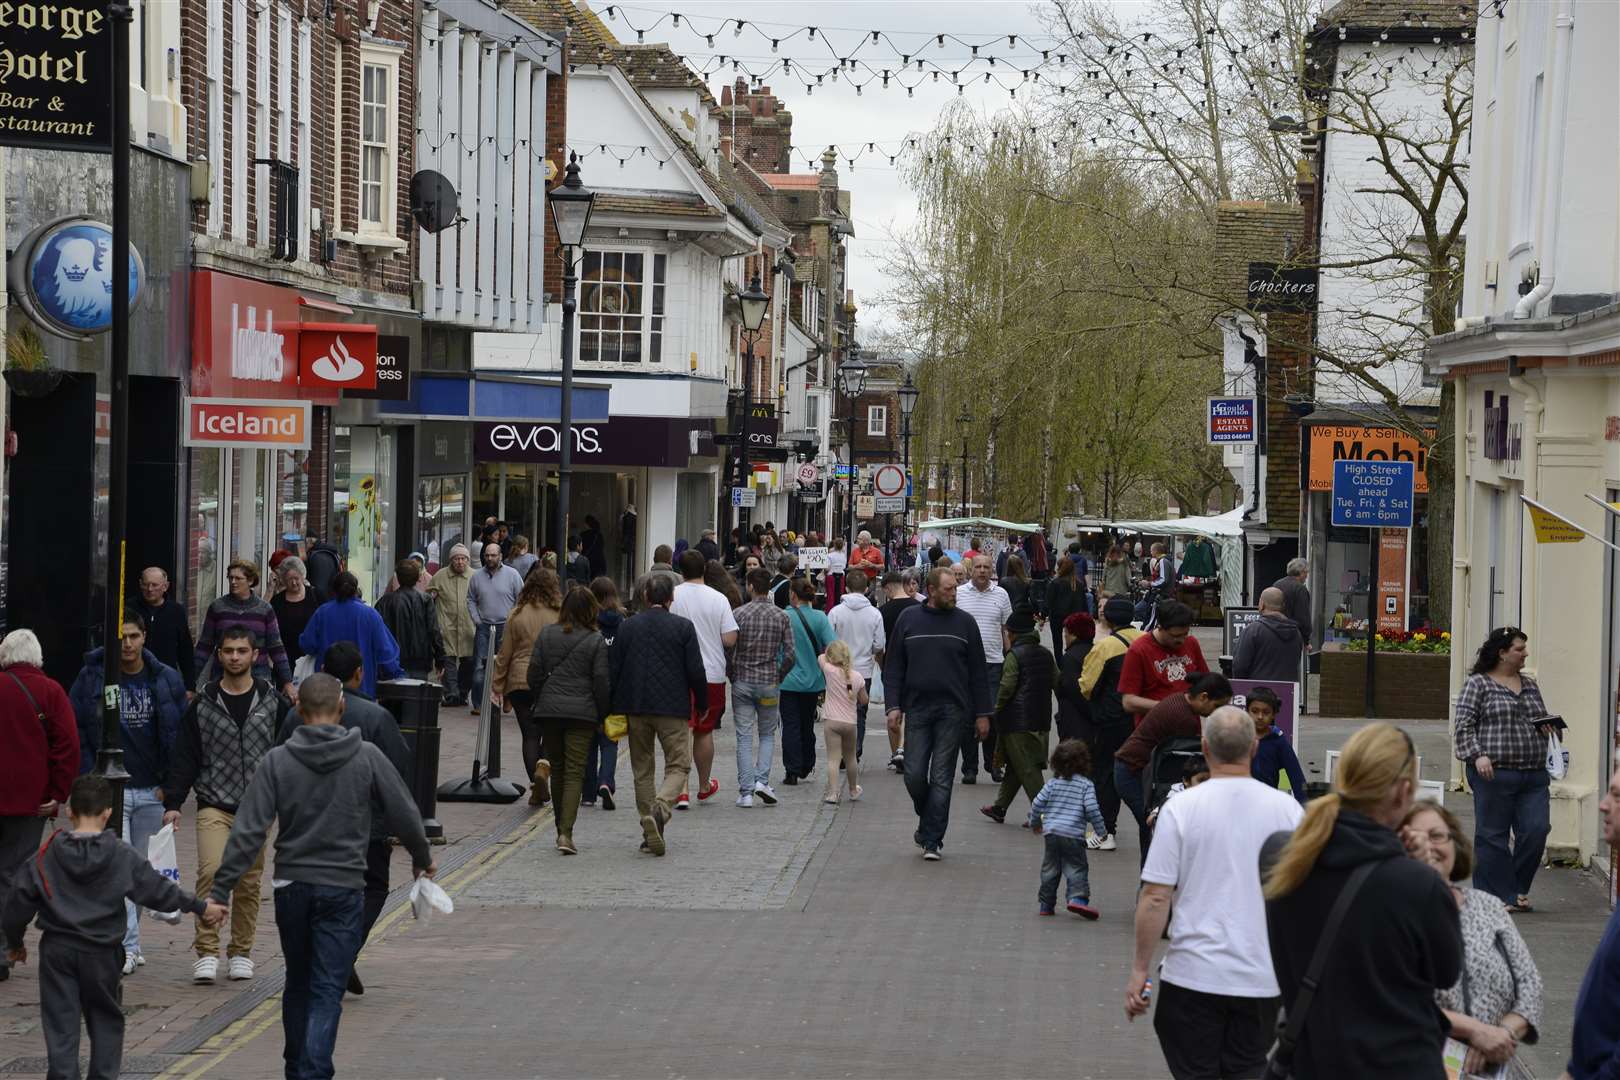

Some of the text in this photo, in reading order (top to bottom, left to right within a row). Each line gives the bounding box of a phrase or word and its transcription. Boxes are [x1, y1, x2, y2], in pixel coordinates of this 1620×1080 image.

[0, 1, 104, 40] eorge
[0, 92, 65, 111] Bar &
[1249, 280, 1316, 295] Chockers
[1212, 406, 1249, 416] Harrison
[1216, 402, 1245, 412] Gould
[199, 410, 296, 437] Iceland
[489, 424, 602, 453] evans.
[1312, 427, 1332, 438] We
[1336, 428, 1359, 440] Buy
[1362, 428, 1372, 438] &
[1375, 428, 1398, 439] Sell
[801, 467, 814, 478] £9
[1345, 464, 1402, 475] High Street
[1352, 476, 1394, 486] CLOSED
[1358, 487, 1388, 496] ahead
[1337, 497, 1409, 509] Tue. Fri. & Sat
[1344, 509, 1352, 518] 6
[1355, 511, 1370, 519] am
[1377, 510, 1400, 520] 6pm
